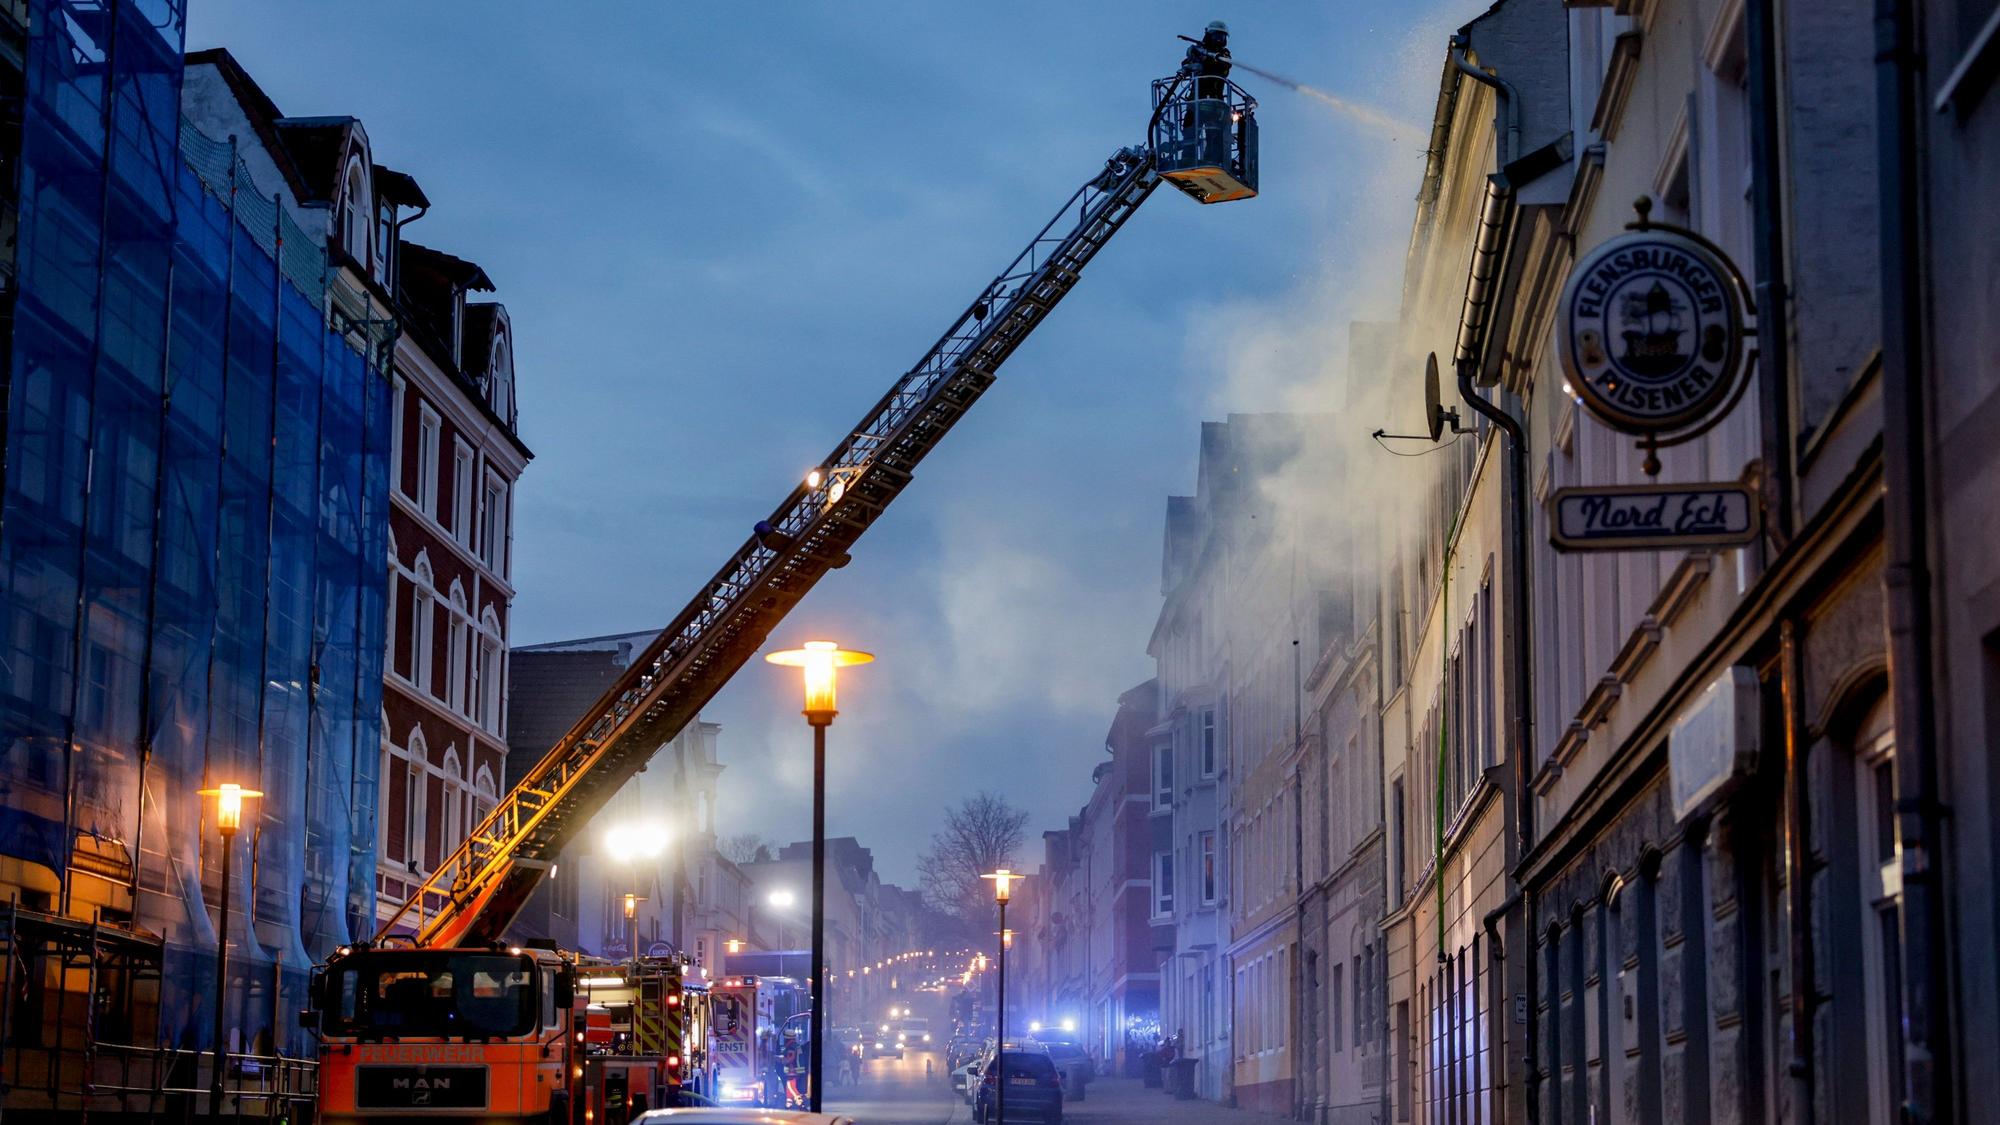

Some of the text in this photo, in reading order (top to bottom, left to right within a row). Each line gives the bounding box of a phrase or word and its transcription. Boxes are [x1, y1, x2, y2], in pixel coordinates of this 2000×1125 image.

[1579, 250, 1722, 318] FLENSBURGER
[1597, 364, 1714, 410] PILSENER
[1581, 494, 1727, 533] Nord Eck
[361, 1046, 484, 1061] FEUERWEHR
[714, 1043, 744, 1052] IENST
[393, 1078, 450, 1089] MAN
